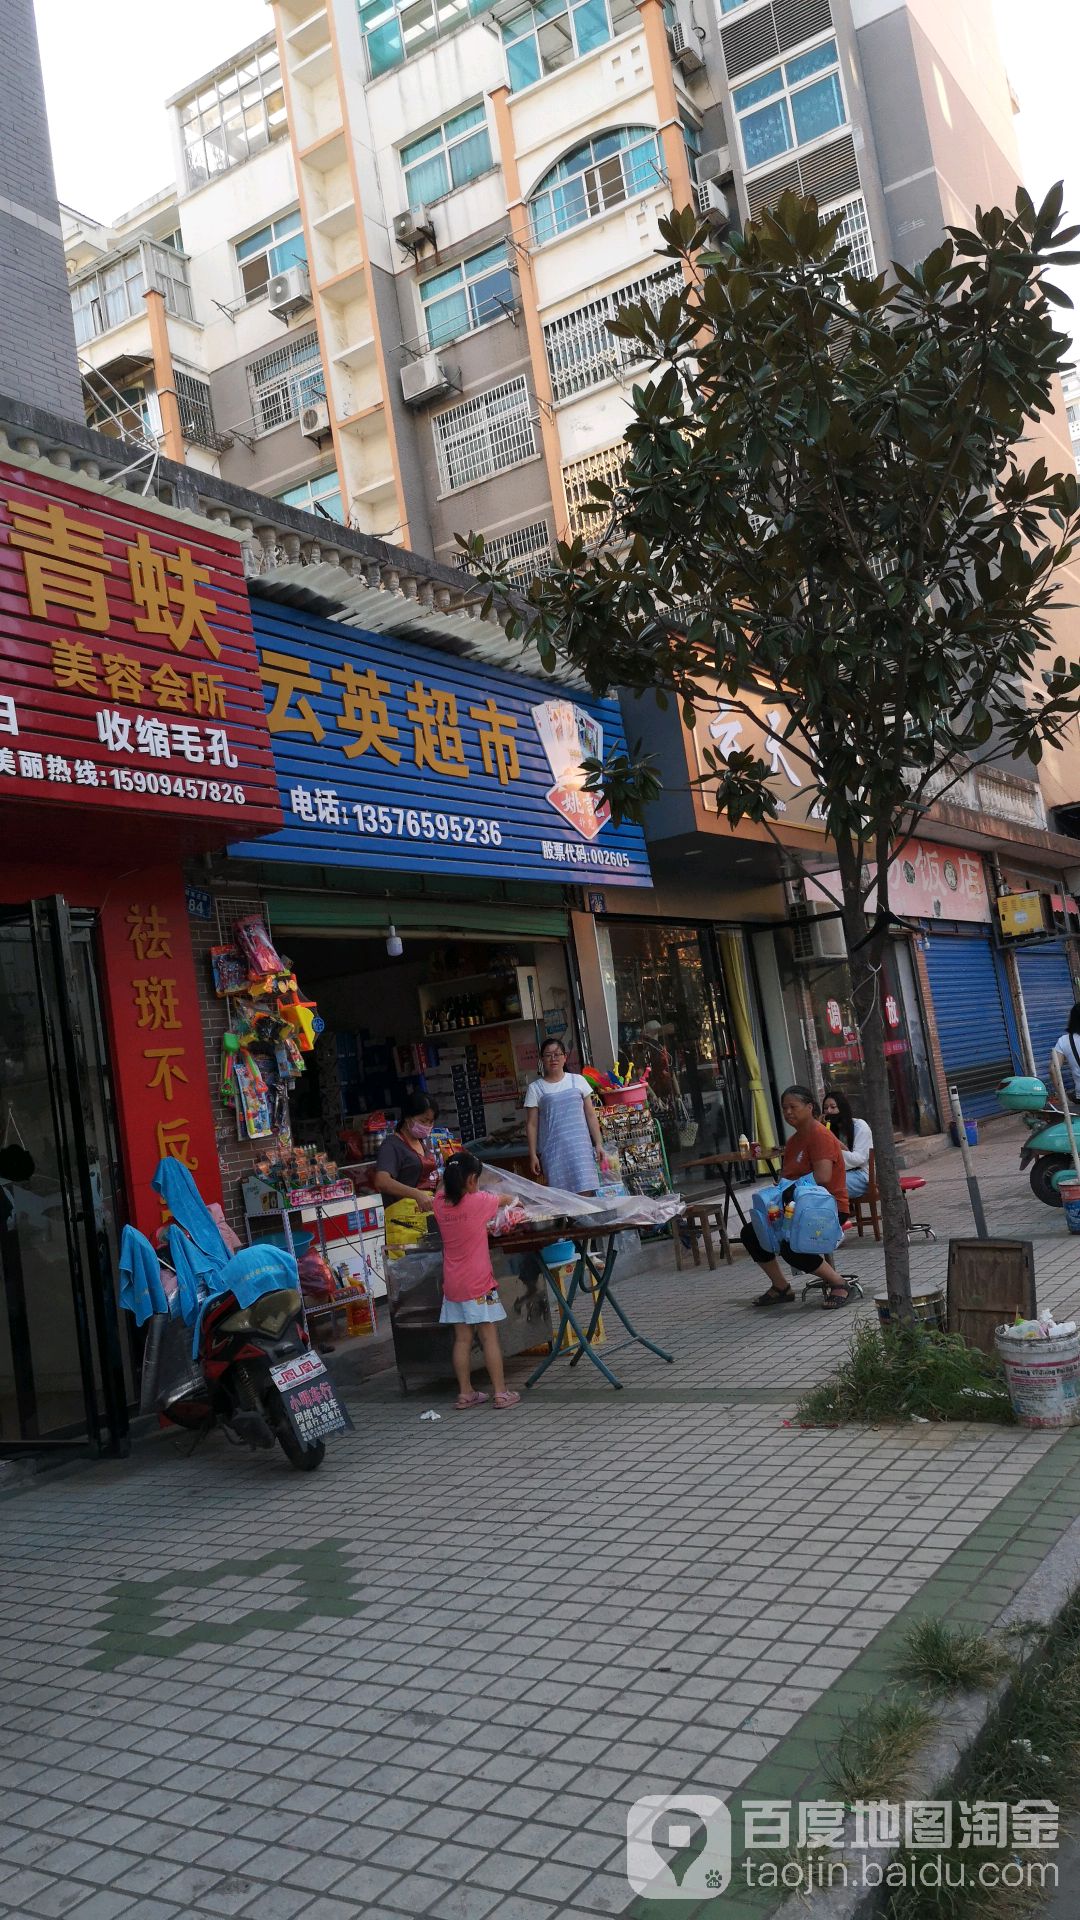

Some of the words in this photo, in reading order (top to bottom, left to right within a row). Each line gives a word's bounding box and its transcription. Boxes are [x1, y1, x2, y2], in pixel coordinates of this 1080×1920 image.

[50, 637, 227, 719] 美容会所
[96, 709, 238, 768] 收缩毛孔
[260, 650, 521, 785] 云英超市
[290, 785, 502, 846] 电话:13576595236
[541, 840, 630, 867] 股票代码:002605
